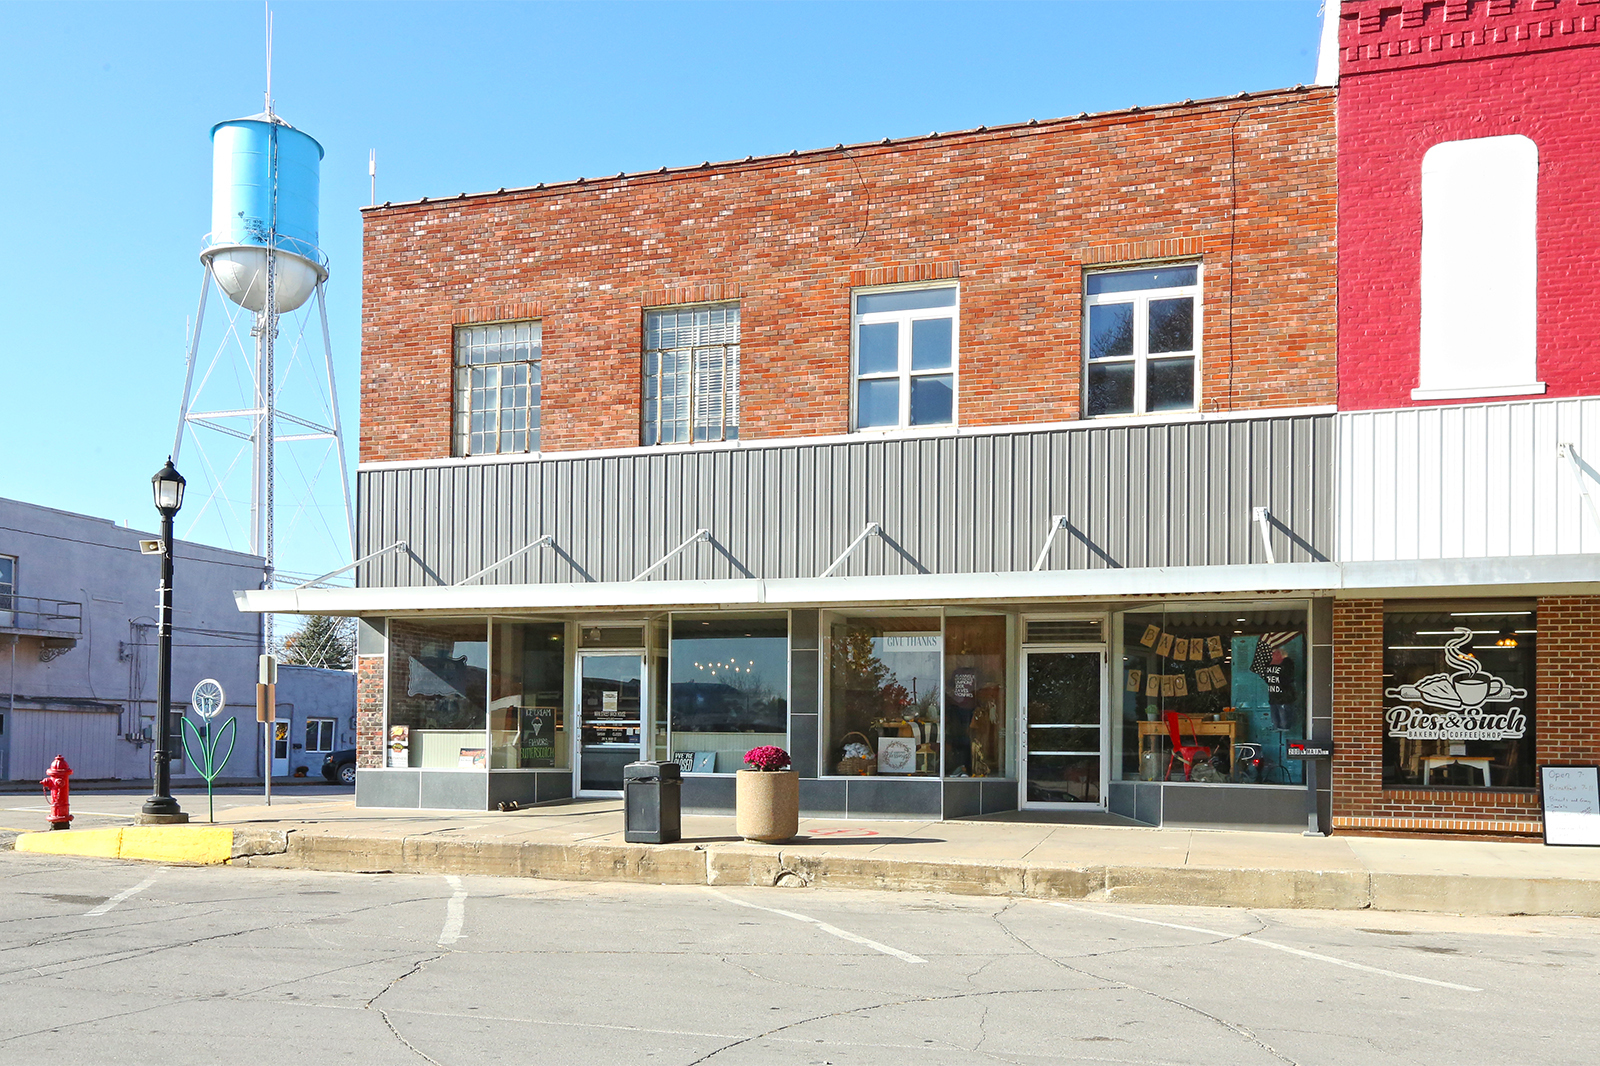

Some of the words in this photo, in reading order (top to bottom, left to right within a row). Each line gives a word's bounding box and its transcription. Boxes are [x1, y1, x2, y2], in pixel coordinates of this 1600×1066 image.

[906, 636, 938, 647] THANKS
[1144, 628, 1201, 655] BACK
[1211, 637, 1220, 653] 2
[533, 709, 552, 717] CREAM
[1386, 706, 1439, 731] Pies
[1443, 712, 1461, 730] &
[1463, 706, 1526, 733] Such
[1449, 731, 1478, 739] COFFEE
[1548, 769, 1570, 781] Open
